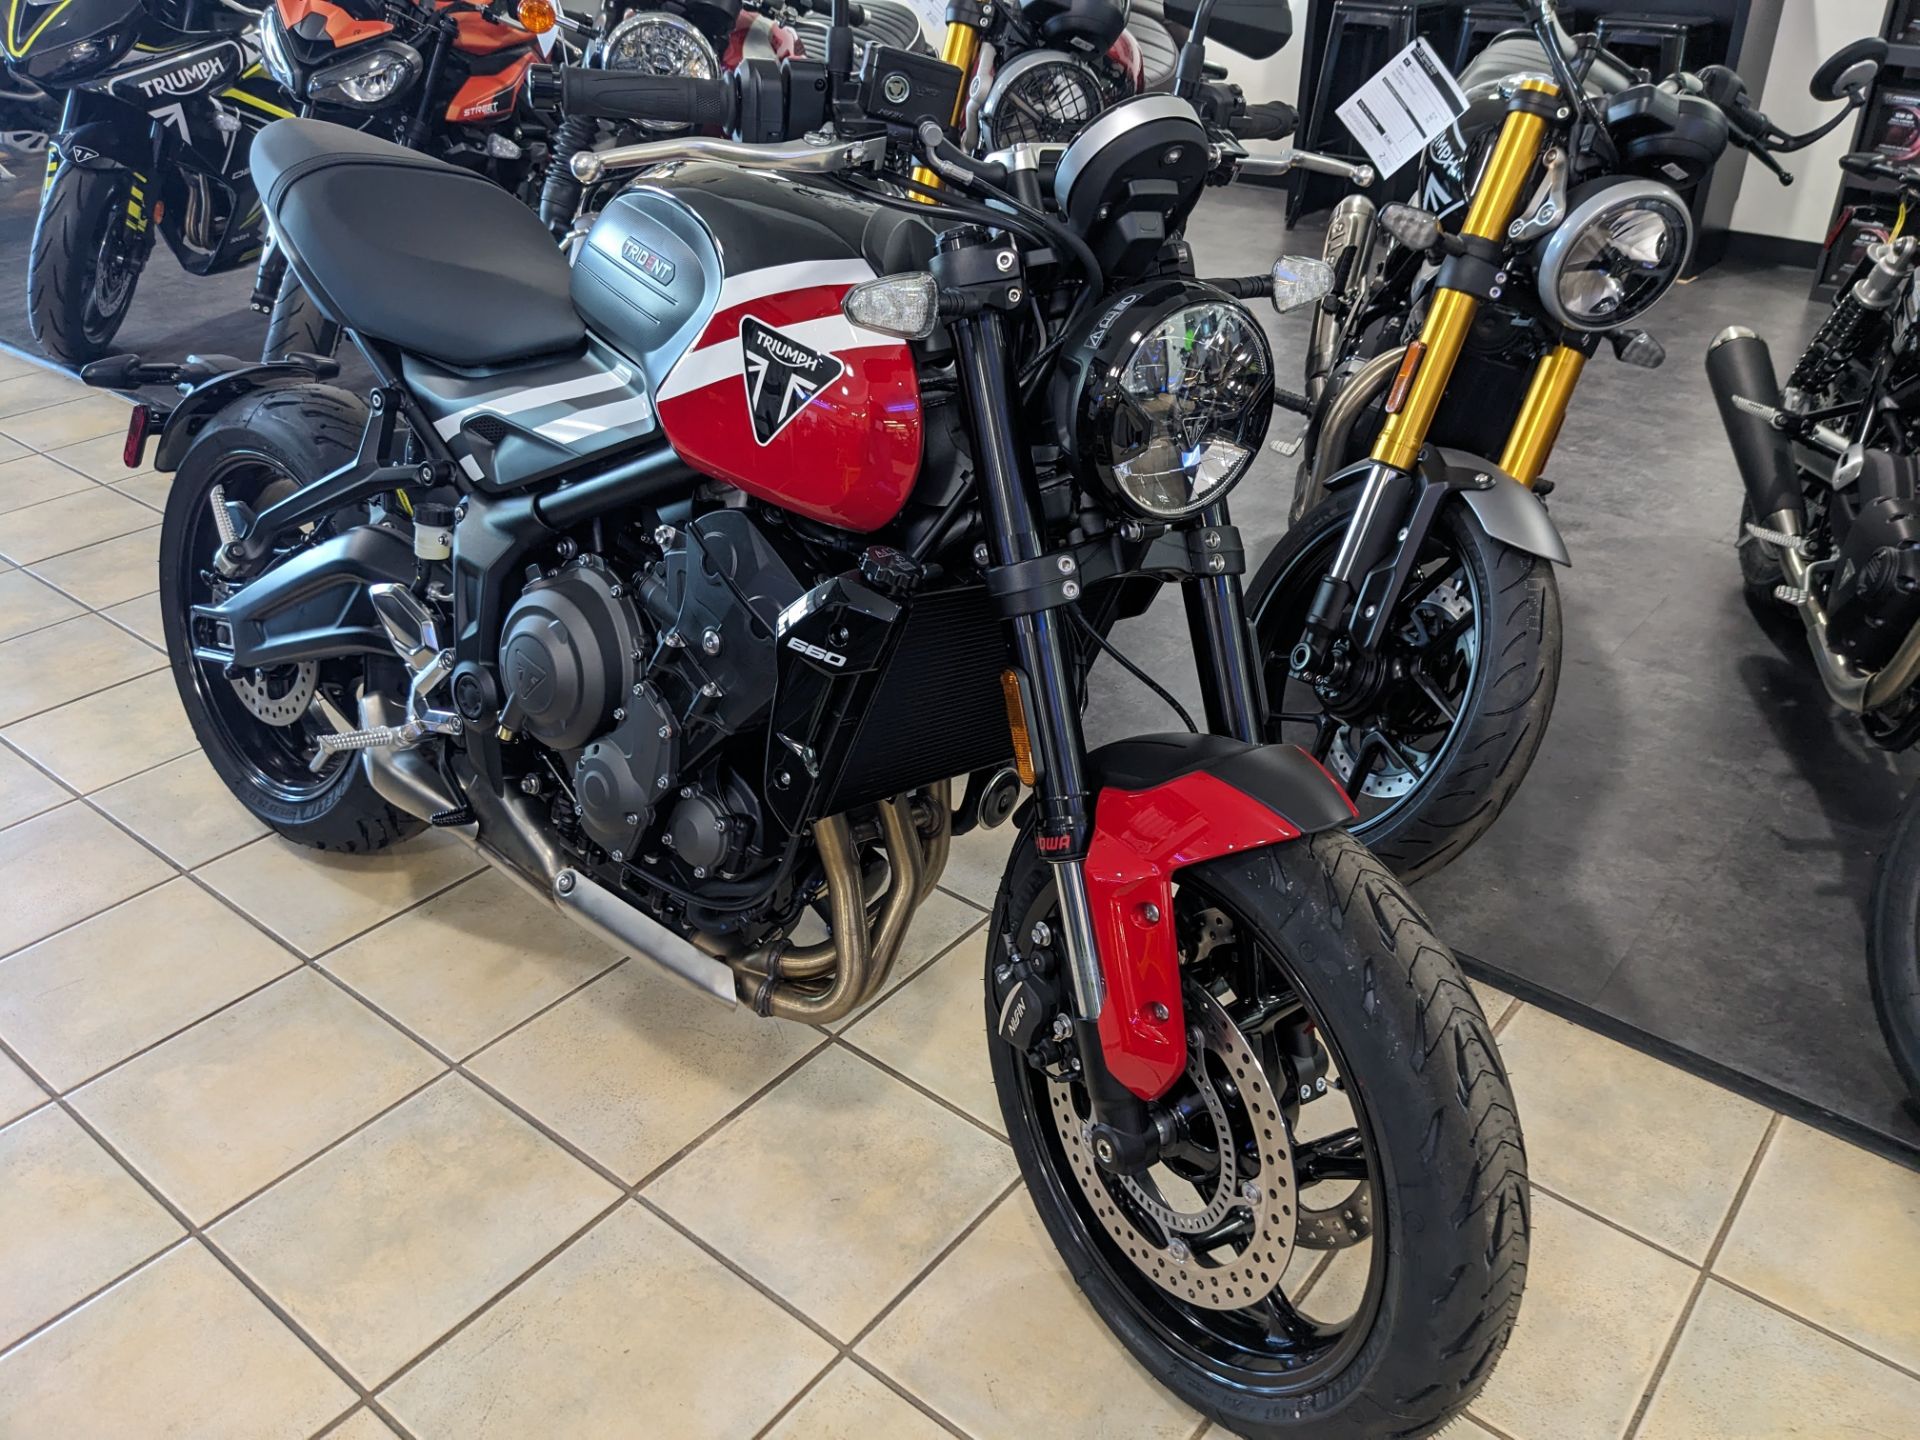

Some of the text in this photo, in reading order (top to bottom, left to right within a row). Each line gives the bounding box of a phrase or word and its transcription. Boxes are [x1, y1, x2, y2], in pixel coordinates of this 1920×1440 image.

[138, 57, 225, 98] TRIUMPH
[463, 101, 499, 117] STREET
[623, 240, 673, 279] TRIDENT
[757, 331, 819, 372] TRIUMPH
[786, 636, 847, 668] 660
[1008, 996, 1026, 1037] NISSIN
